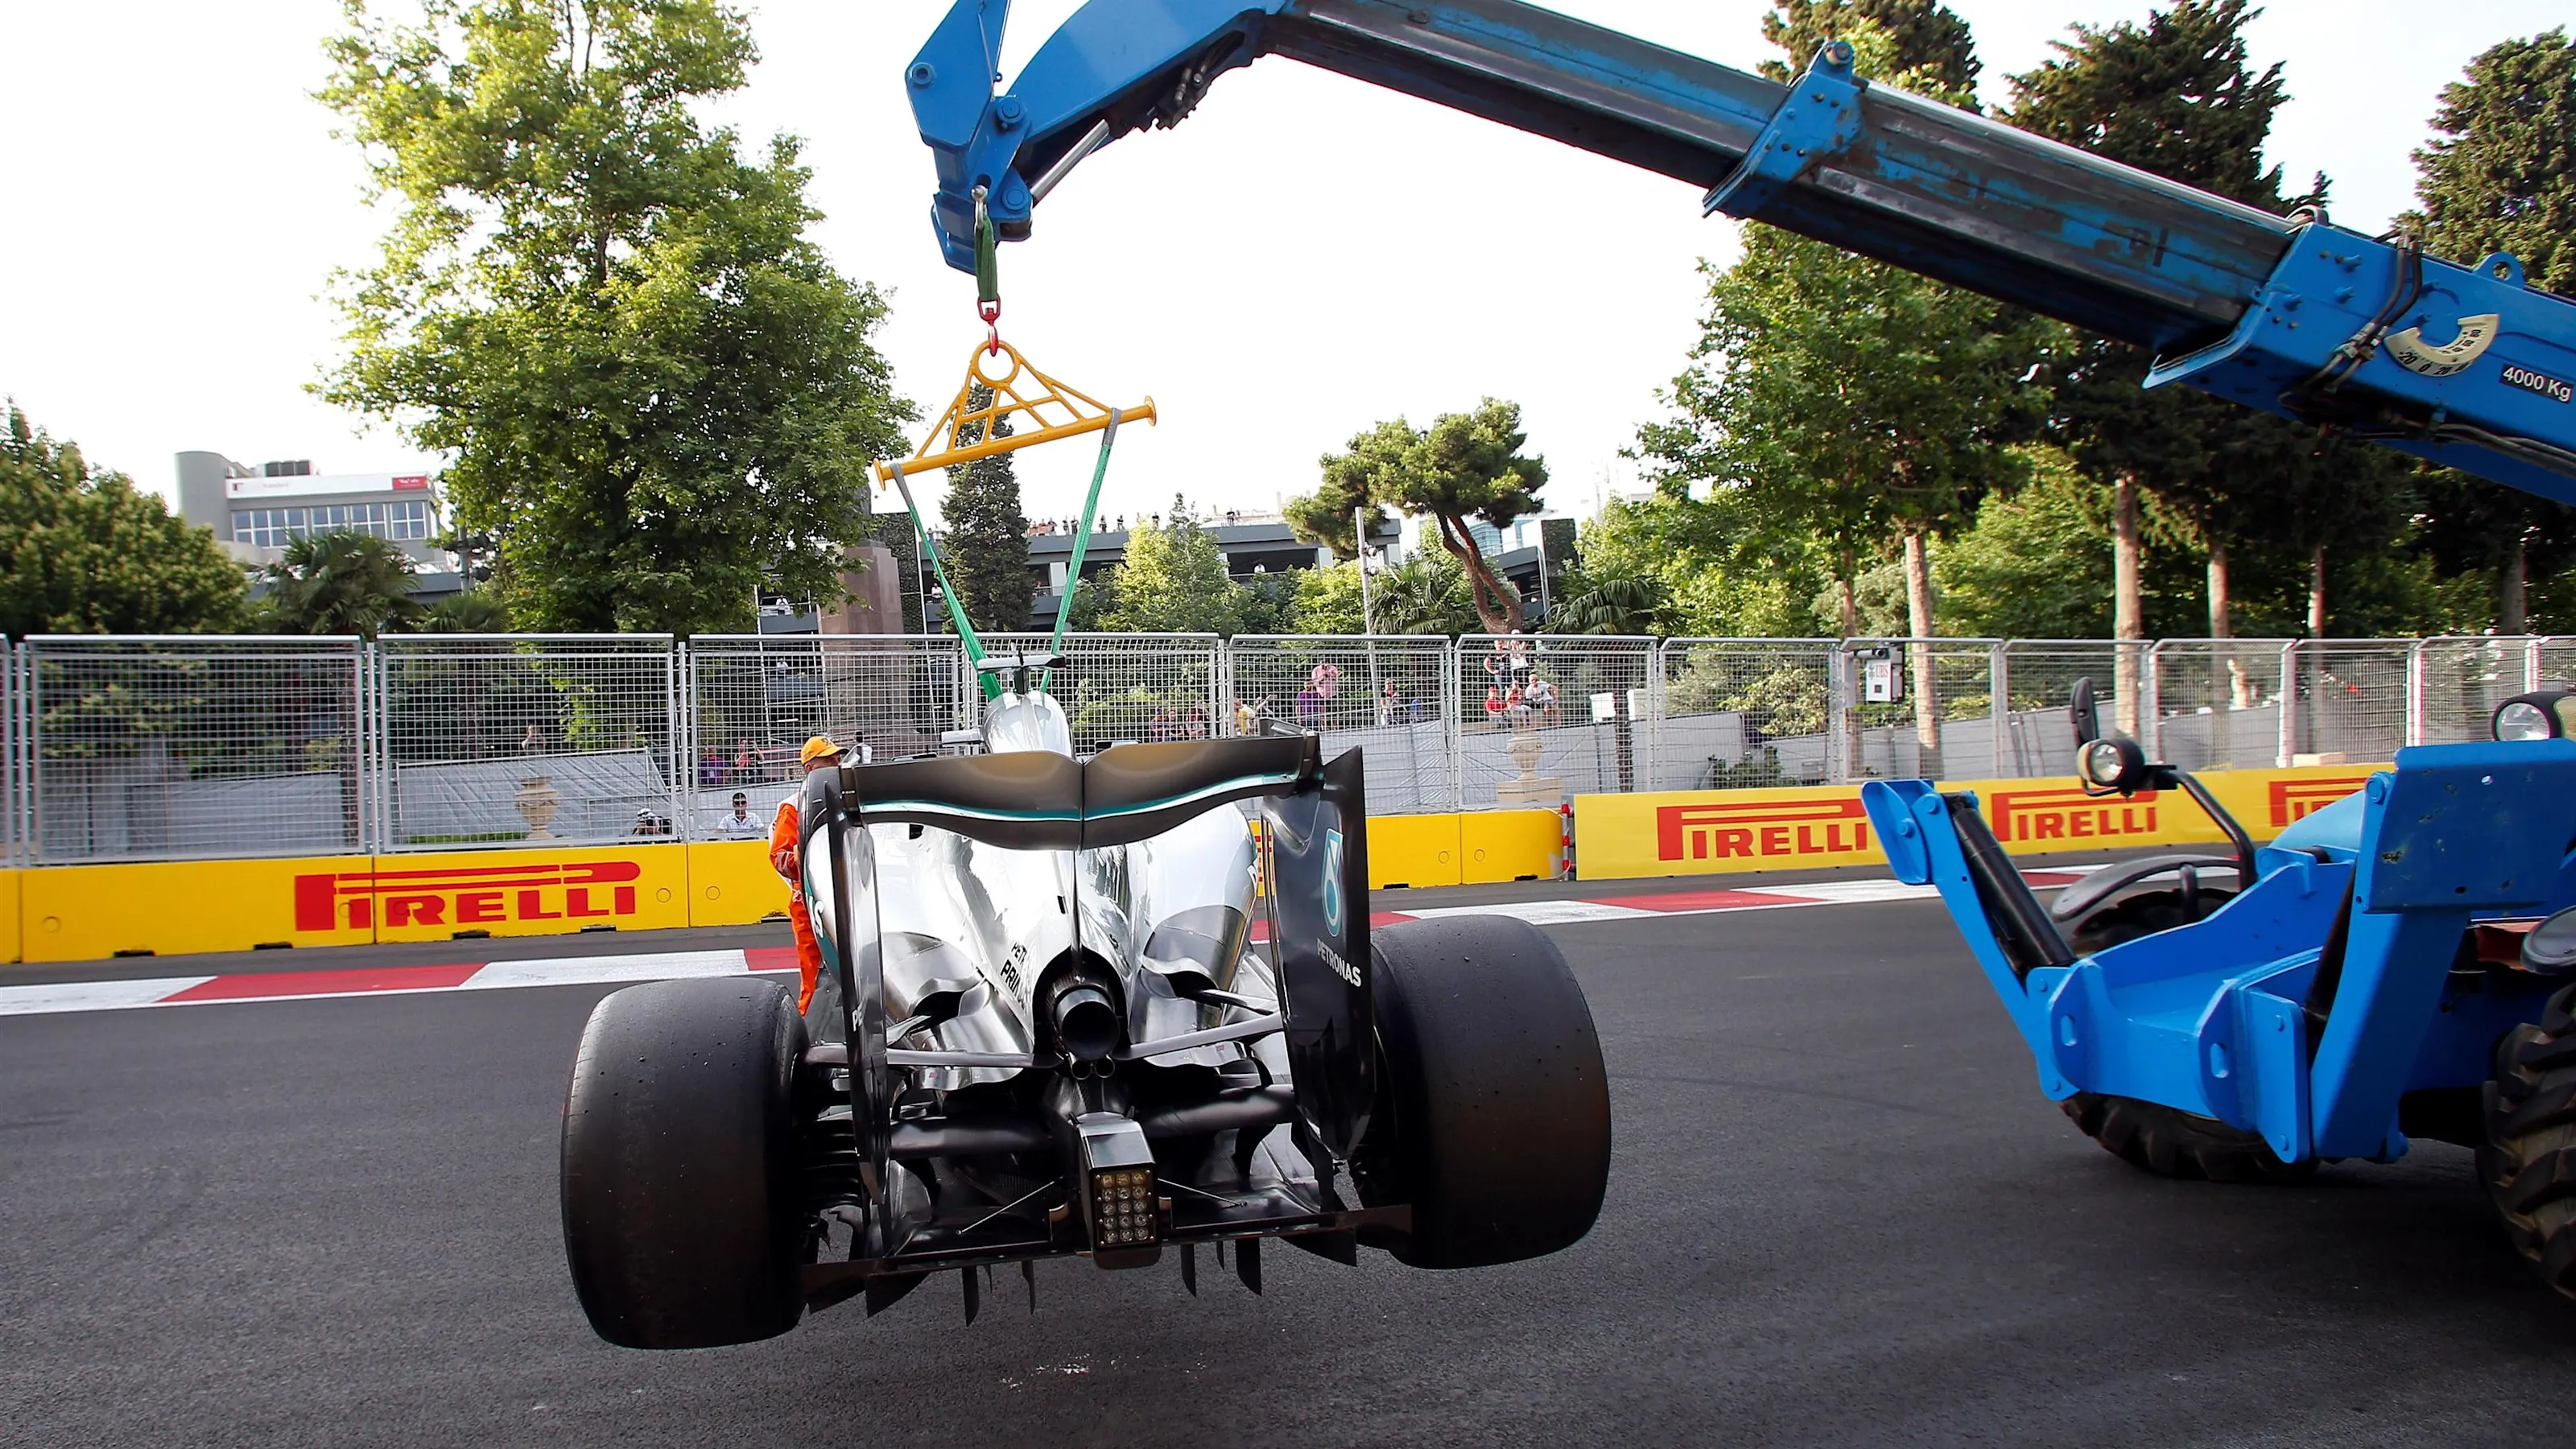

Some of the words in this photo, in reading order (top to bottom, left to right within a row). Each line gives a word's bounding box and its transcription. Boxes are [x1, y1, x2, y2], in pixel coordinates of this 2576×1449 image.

[2503, 366, 2544, 390] 4000
[2547, 379, 2571, 402] Kg
[1657, 798, 1868, 861] PIRELLI
[1991, 785, 2157, 843] PIRELLI
[295, 861, 641, 932] PIRELLI
[1316, 938, 1362, 988] PETRONAS
